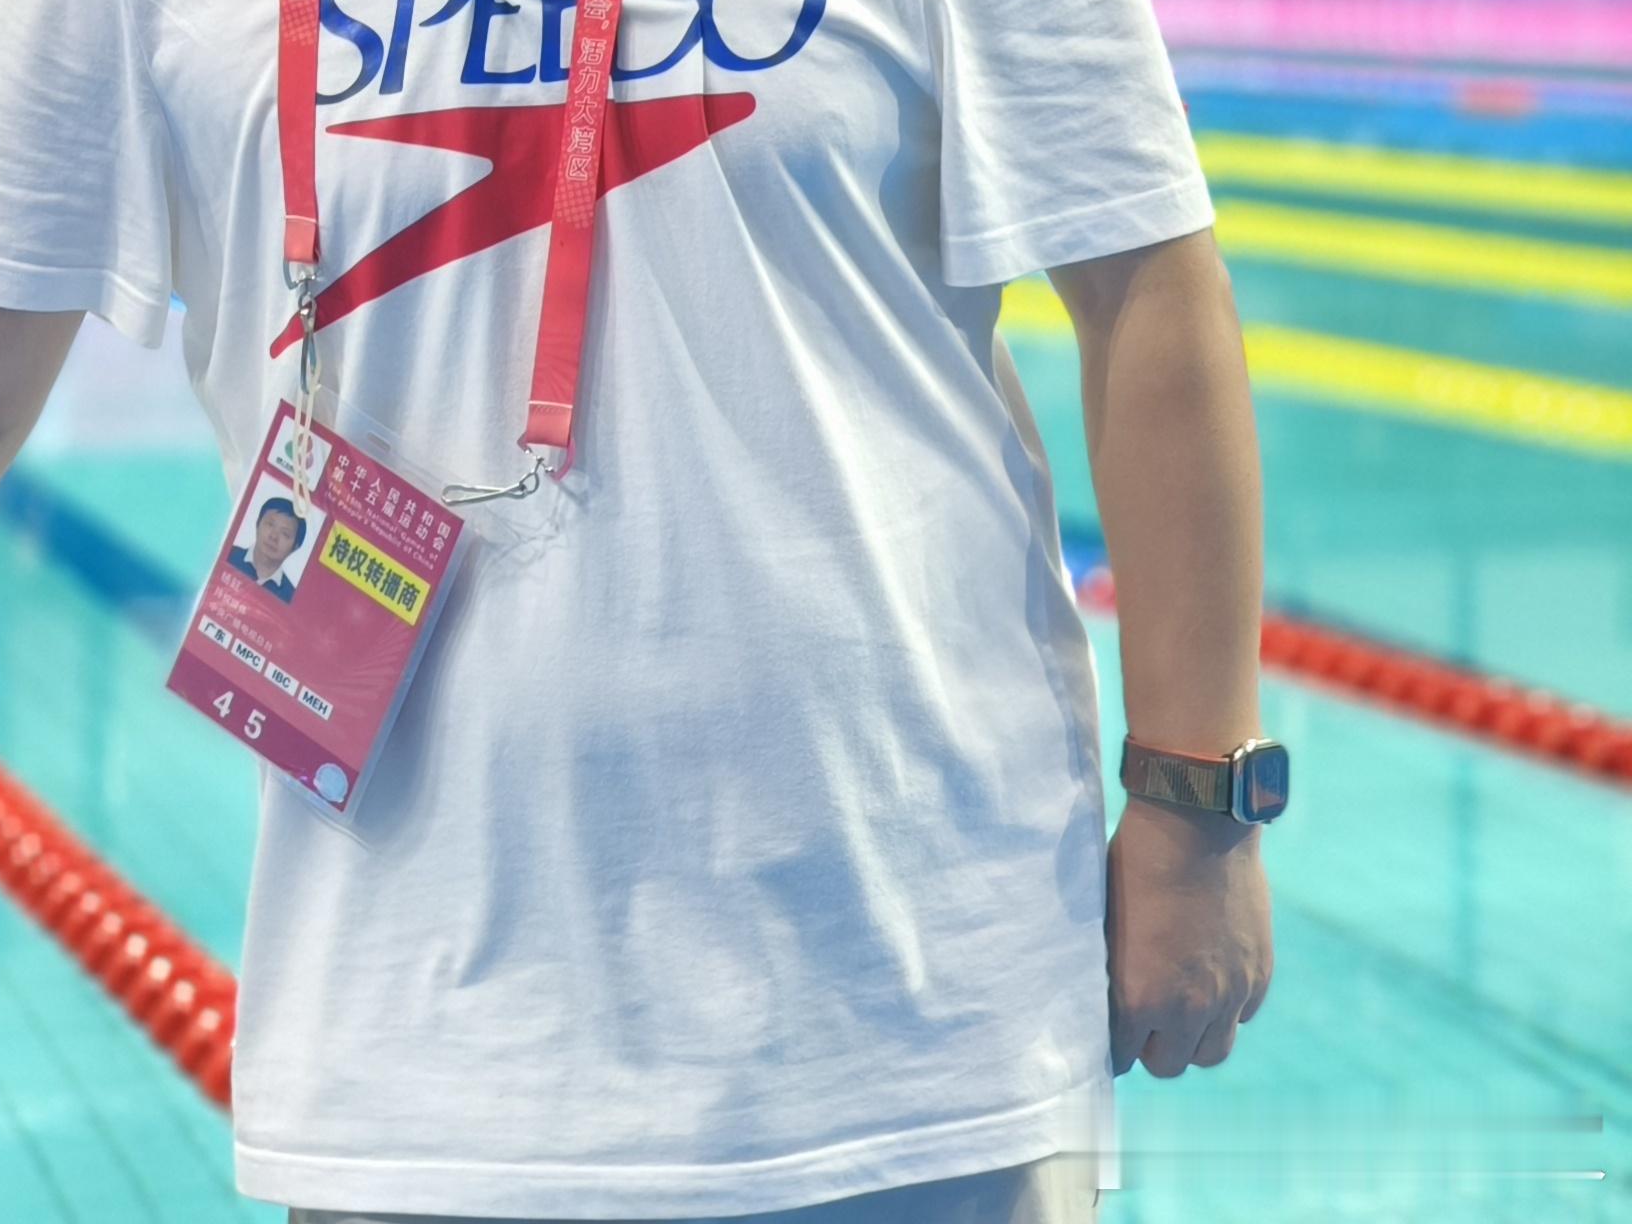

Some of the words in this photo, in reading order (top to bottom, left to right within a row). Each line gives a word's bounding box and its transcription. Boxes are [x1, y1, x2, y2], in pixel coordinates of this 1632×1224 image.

[332, 466, 445, 552] 第十五届运动会
[337, 454, 451, 539] 中华人民共和国
[328, 533, 421, 613] 持权转播商
[204, 622, 226, 644] 广东
[212, 690, 235, 718] 4
[244, 708, 267, 739] 5
[235, 643, 262, 668] MPC
[271, 668, 292, 690] IBC
[302, 691, 329, 716] MEH
